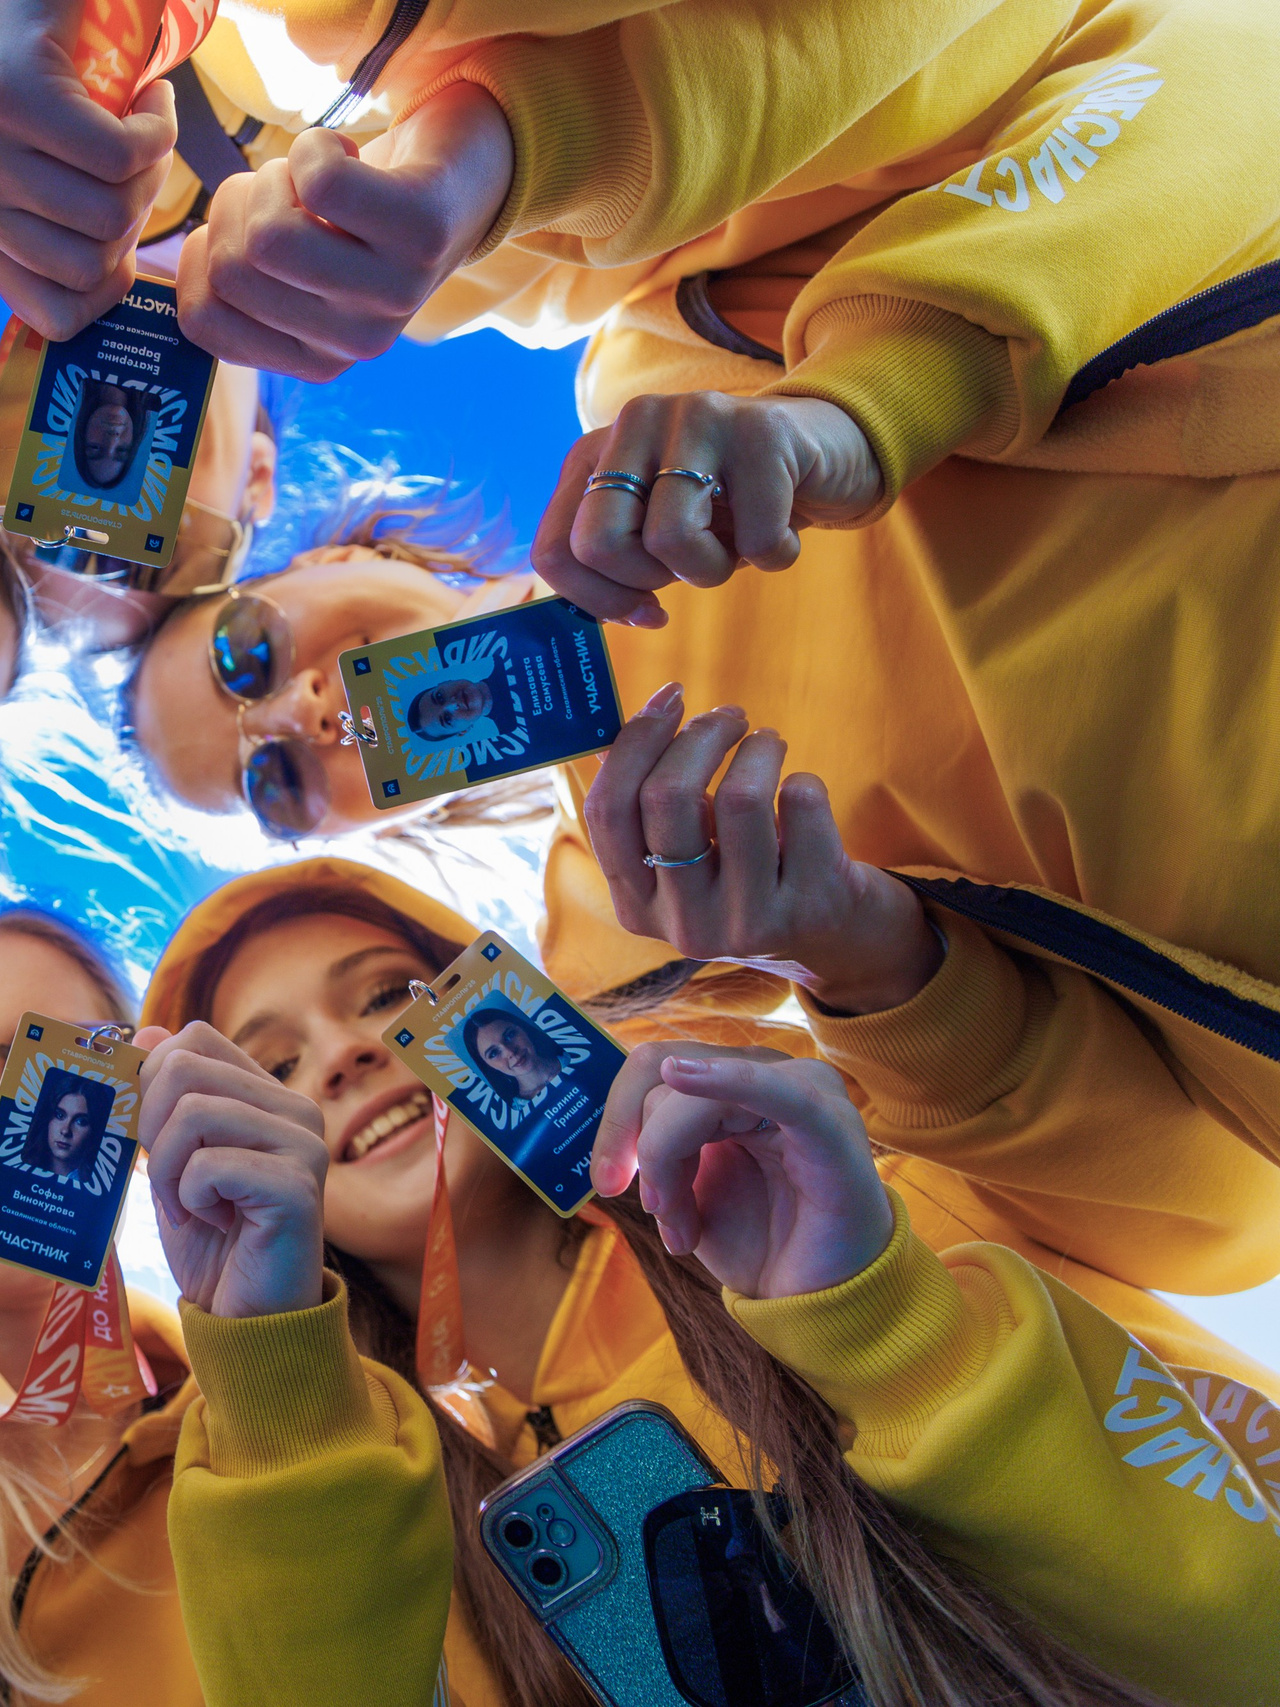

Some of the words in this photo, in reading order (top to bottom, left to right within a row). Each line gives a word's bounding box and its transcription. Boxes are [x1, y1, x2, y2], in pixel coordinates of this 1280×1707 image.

[118, 294, 178, 317] ЧАСТН
[102, 339, 162, 363] Баранова
[126, 326, 180, 346] Сахалинская
[96, 351, 161, 376] Екатерина
[550, 636, 562, 669] область
[522, 656, 543, 717] Елизавета
[535, 654, 554, 712] Самусева
[572, 629, 602, 715] УЧАСТНИК
[557, 668, 574, 720] Сахалинская
[543, 1086, 580, 1120] Полина
[552, 1094, 590, 1129] Гришай
[552, 1117, 594, 1155] Сахалинская
[12, 1189, 75, 1218] Винокурова
[30, 1183, 64, 1202] Софья
[1, 1205, 48, 1226] Сахалинская
[48, 1222, 77, 1236] область
